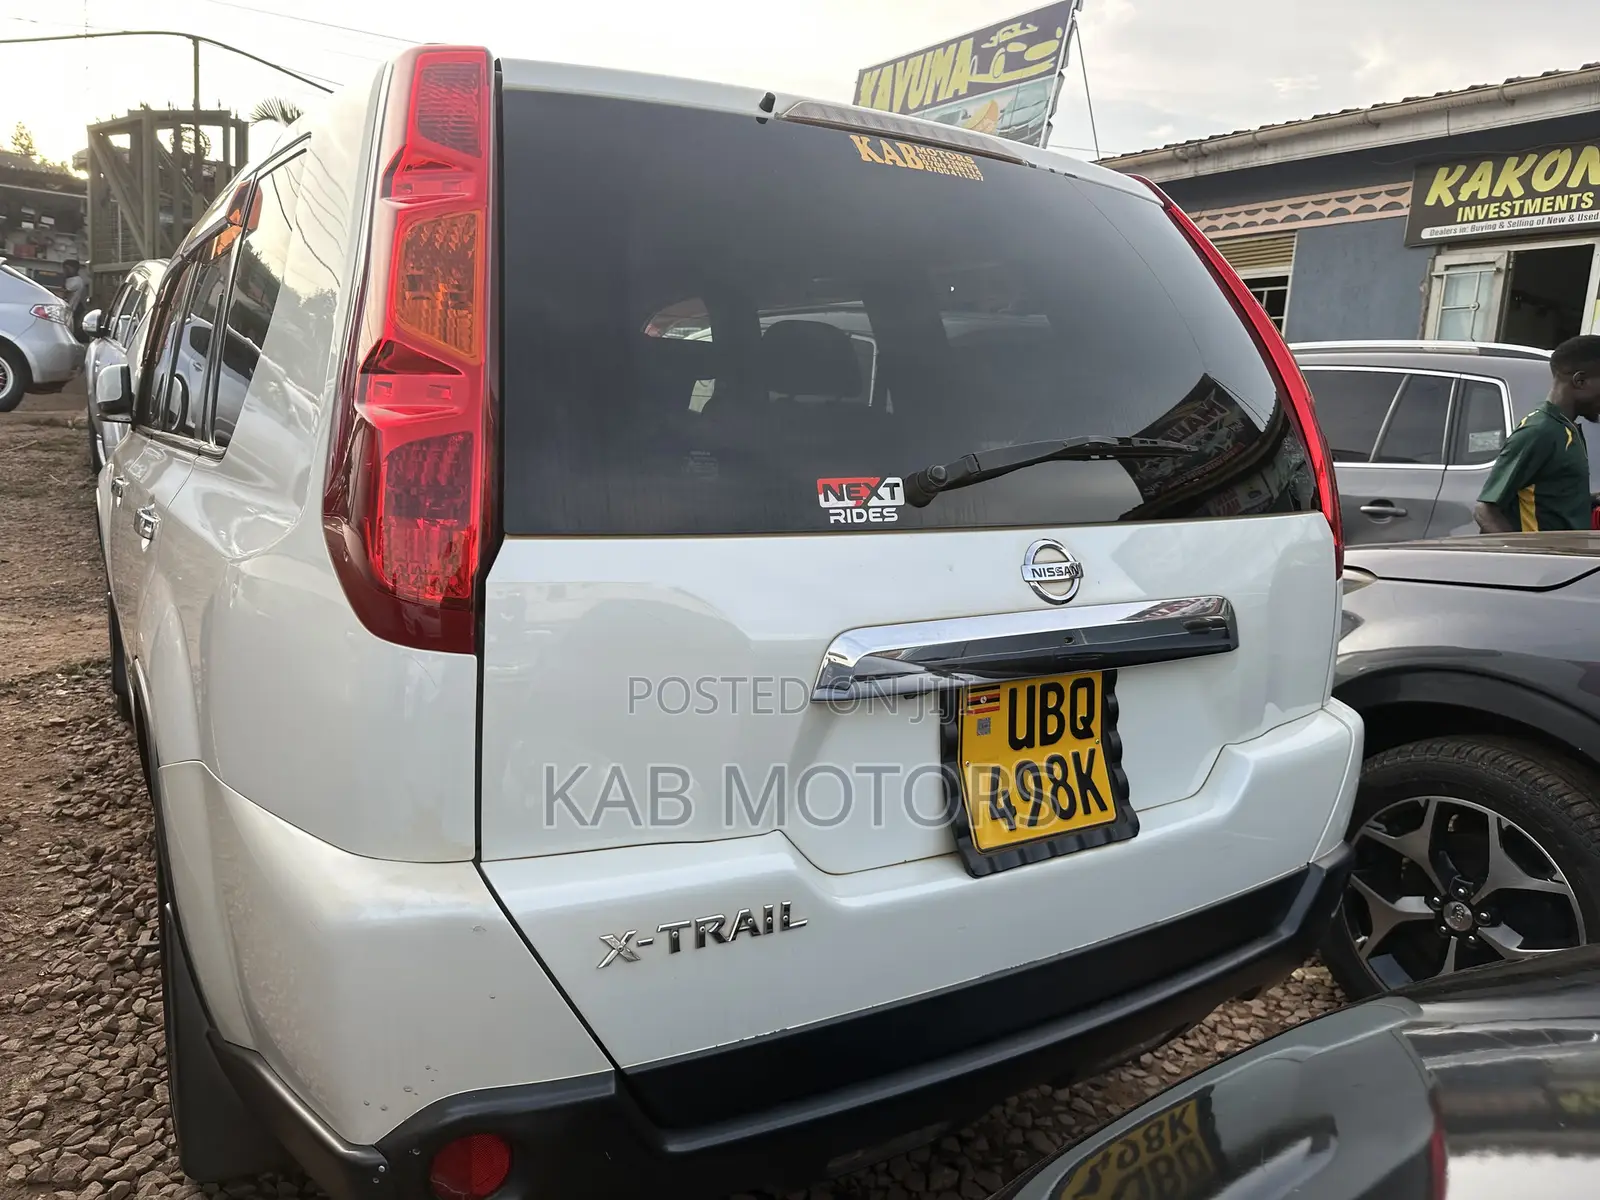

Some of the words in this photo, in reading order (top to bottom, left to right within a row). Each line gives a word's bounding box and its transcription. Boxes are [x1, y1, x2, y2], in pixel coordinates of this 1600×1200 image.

[859, 37, 974, 112] KAVUMA
[849, 135, 924, 169] KAB
[914, 146, 975, 164] MOTORS
[1456, 191, 1595, 223] INVESTMENTS
[1429, 227, 1458, 237] Dealers
[1470, 223, 1497, 233] Buying
[1498, 220, 1505, 229] &
[1506, 218, 1534, 229] Selling
[1536, 216, 1545, 226] of
[1546, 215, 1566, 225] New
[1567, 213, 1575, 222] &
[1577, 211, 1600, 222] Used
[819, 478, 902, 507] NEXT
[829, 507, 898, 524] RIDES
[1031, 563, 1081, 579] NISSAN
[1008, 676, 1095, 751] UBQ
[989, 747, 1108, 831] 498K
[596, 900, 808, 969] X-TRAIL
